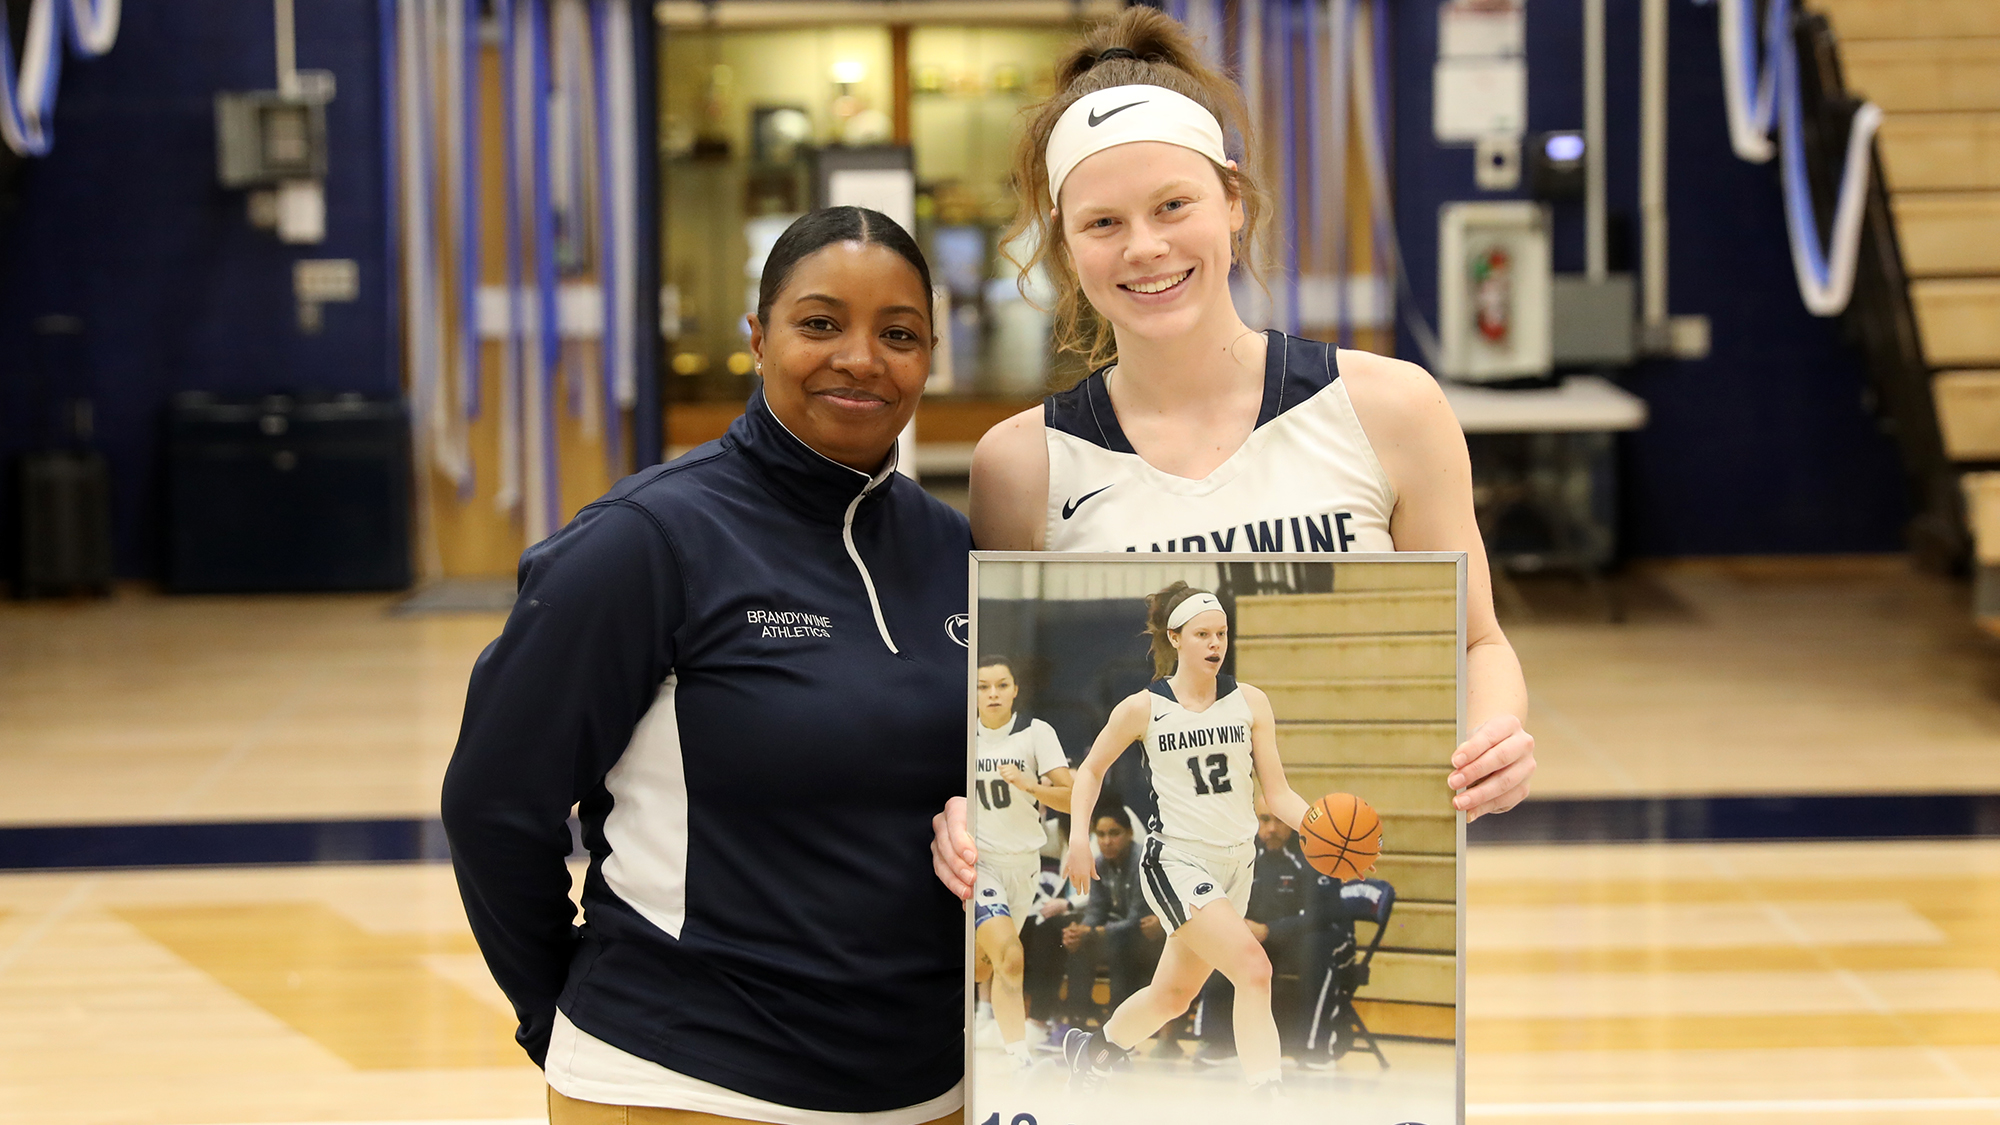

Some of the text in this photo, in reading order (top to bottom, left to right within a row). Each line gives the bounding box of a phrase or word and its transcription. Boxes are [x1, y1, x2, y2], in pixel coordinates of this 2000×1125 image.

[1124, 512, 1356, 552] YWINE
[746, 610, 833, 628] BRANDYWINE
[761, 625, 831, 638] ATHLETICS
[1158, 725, 1245, 752] BRANDYWINE
[976, 758, 1025, 772] NDYNE
[1187, 753, 1233, 796] 12
[975, 779, 1011, 811] 10
